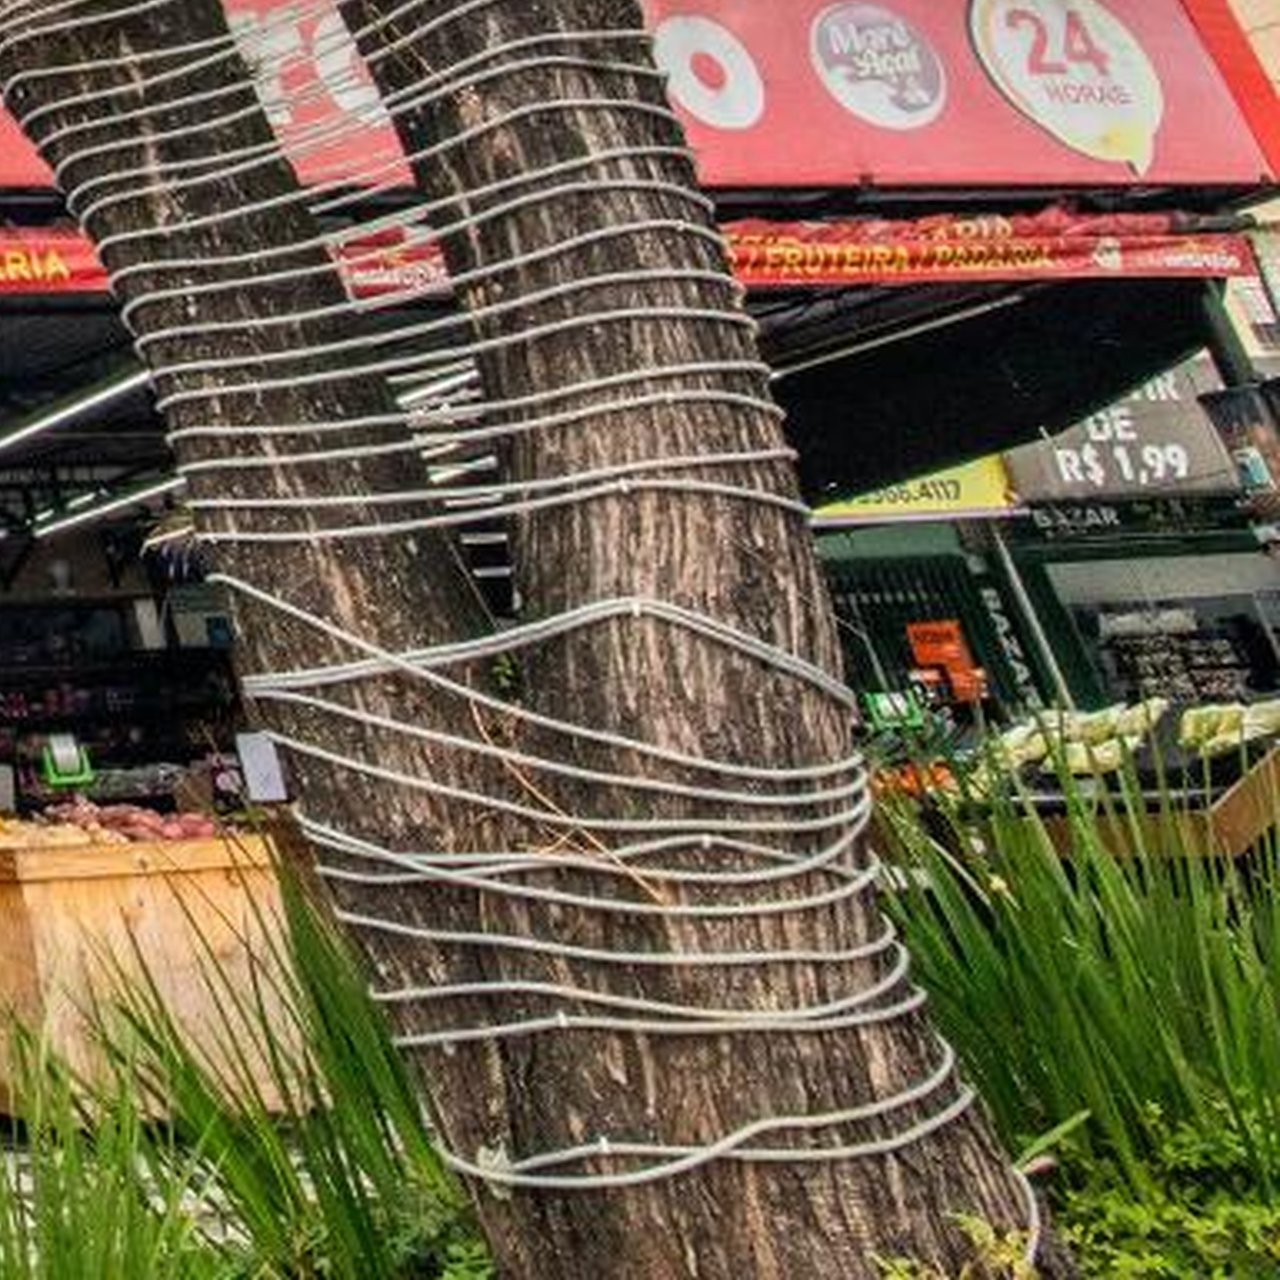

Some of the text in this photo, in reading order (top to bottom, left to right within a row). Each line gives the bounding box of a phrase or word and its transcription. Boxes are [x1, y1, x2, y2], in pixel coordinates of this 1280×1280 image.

[1006, 8, 1110, 76] 24
[765, 242, 911, 275] FRUTEIRA
[1055, 444, 1190, 487] R$ 1,99
